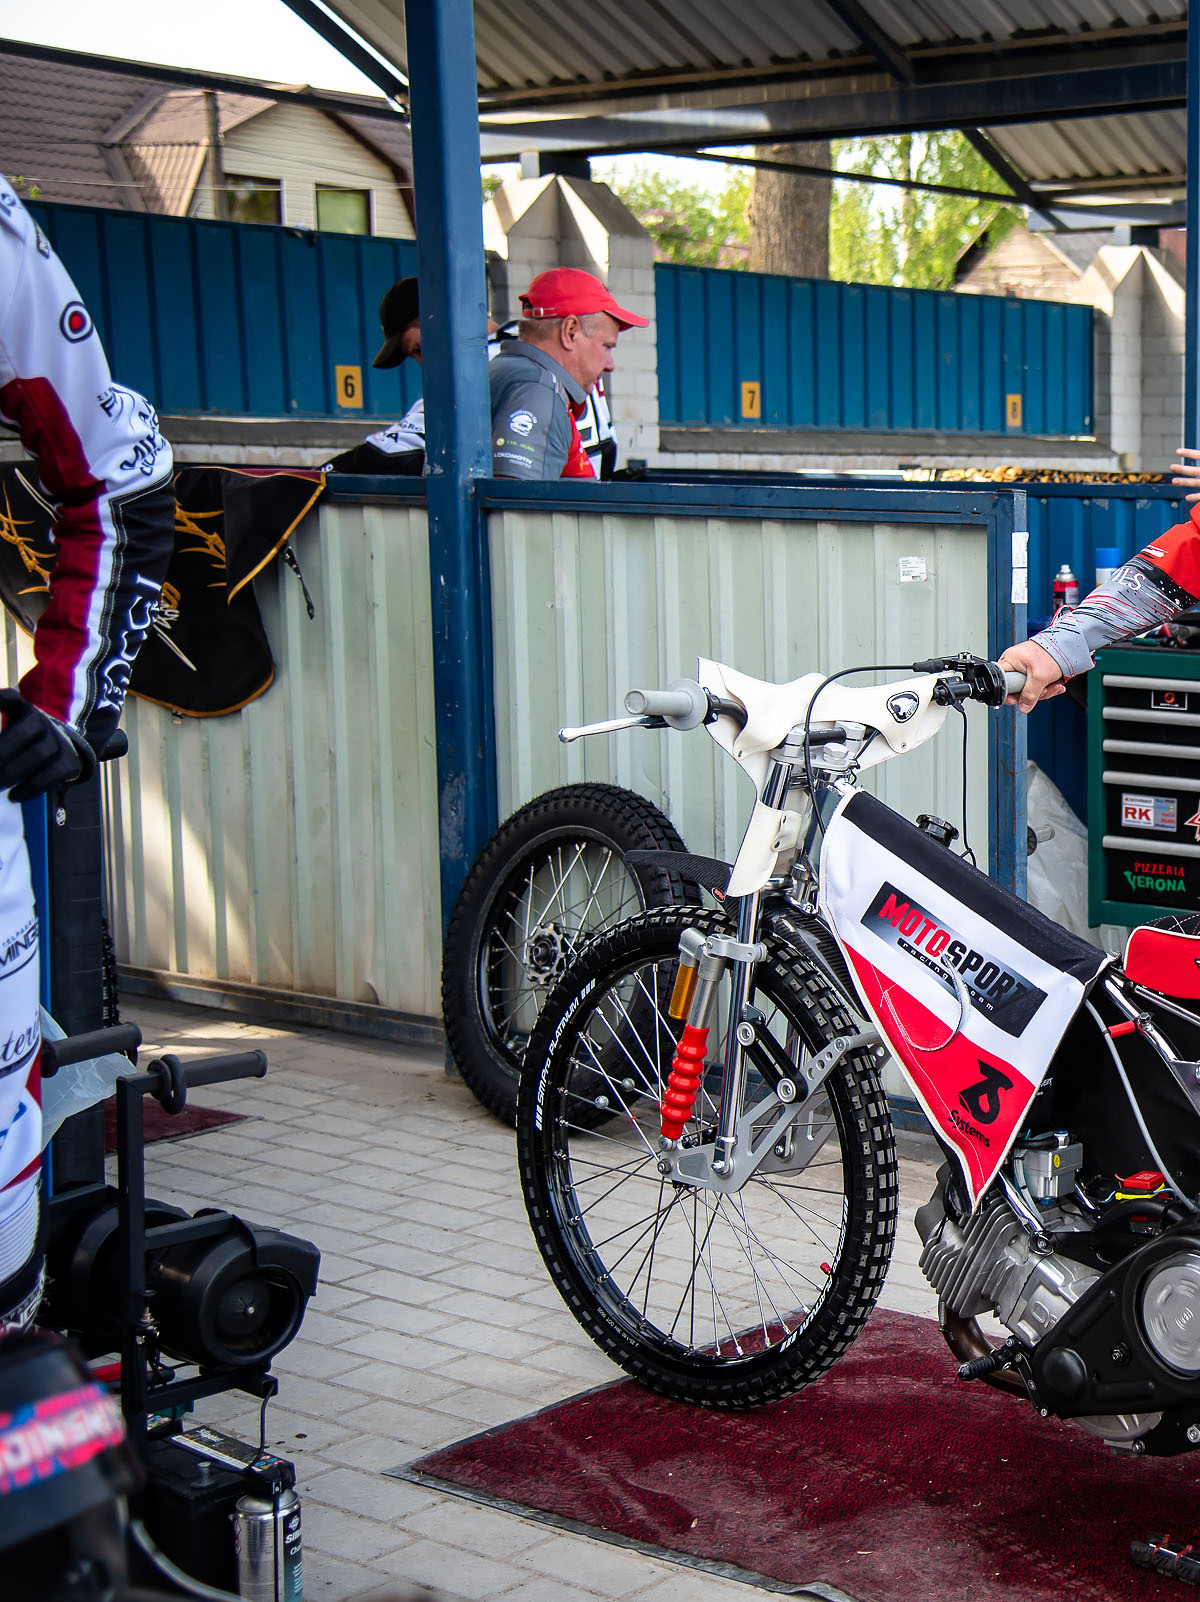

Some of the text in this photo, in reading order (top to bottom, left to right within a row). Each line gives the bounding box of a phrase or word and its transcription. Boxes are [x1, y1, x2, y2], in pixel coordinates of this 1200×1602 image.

[344, 374, 354, 398] 6
[747, 390, 756, 410] 7
[1124, 806, 1152, 821] RK
[1134, 862, 1185, 877] PIZZERIA
[1123, 871, 1187, 892] VERONA
[548, 996, 580, 1056] PLATINUM
[948, 1109, 991, 1148] Systems
